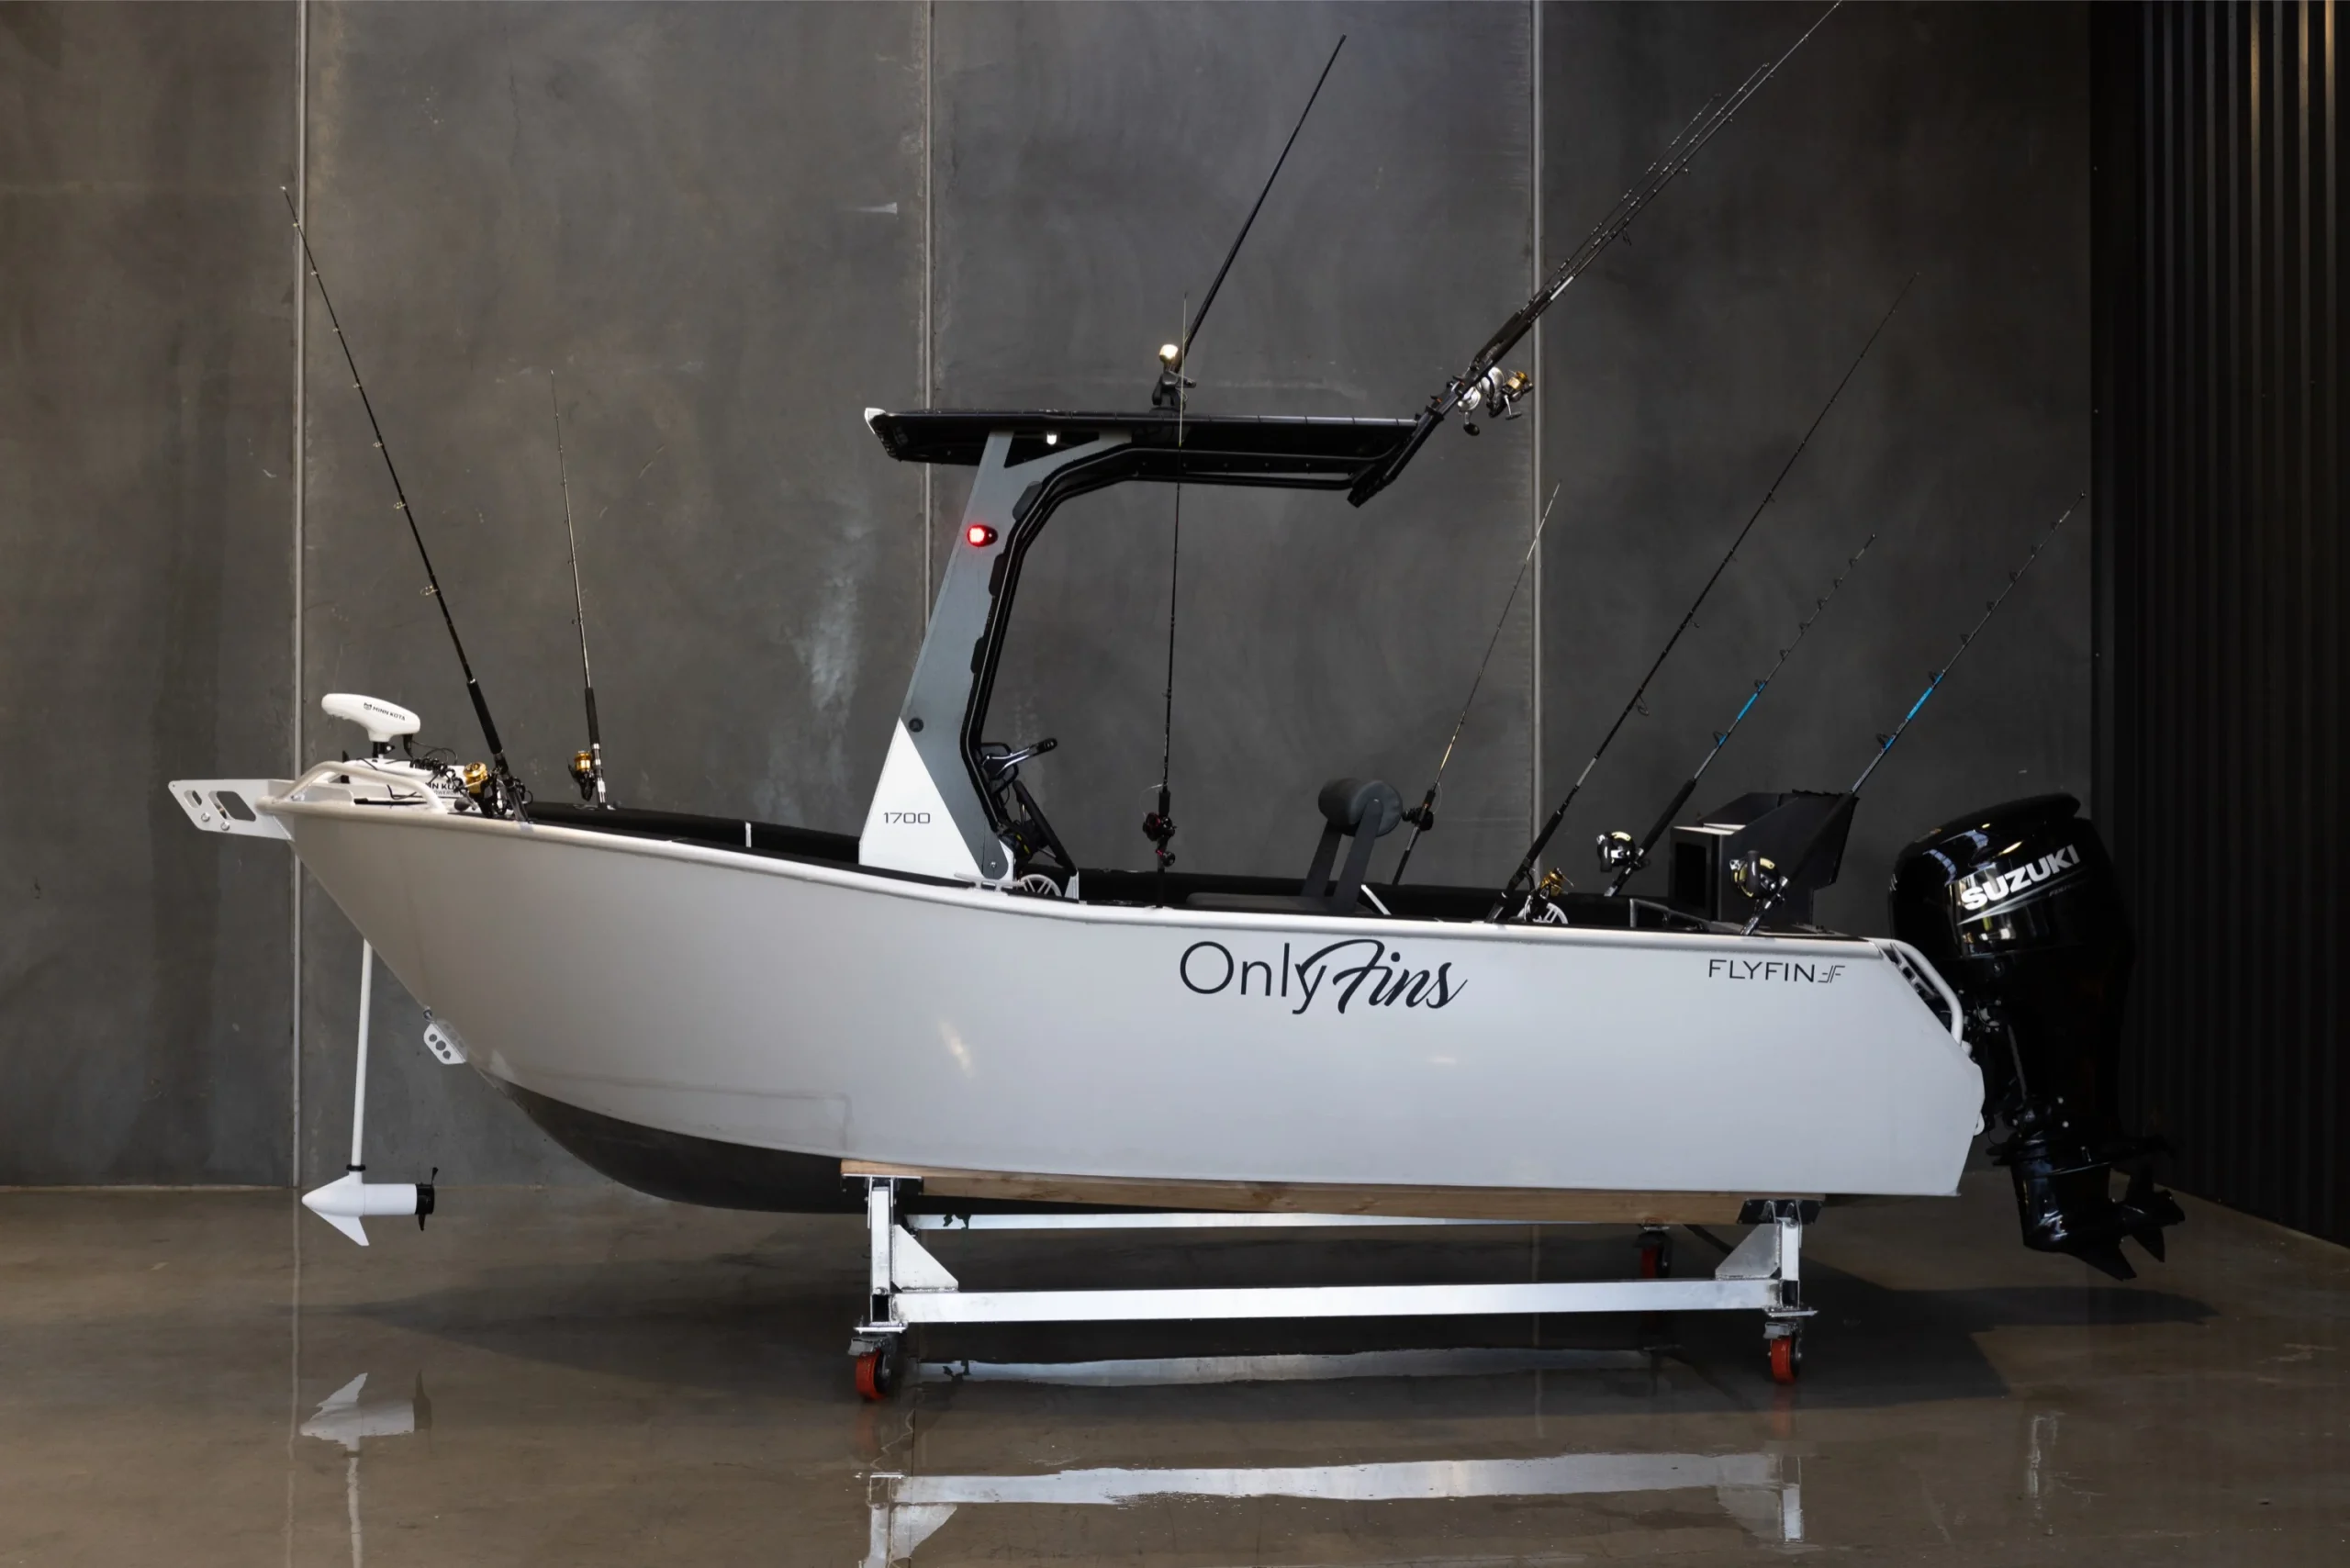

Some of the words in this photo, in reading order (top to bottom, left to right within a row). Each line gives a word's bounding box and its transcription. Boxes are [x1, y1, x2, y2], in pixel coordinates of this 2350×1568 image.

[373, 706, 389, 715] MINN
[389, 711, 406, 721] KOTA
[883, 812, 931, 824] 1700
[1961, 844, 2080, 911] SUZUKI
[1708, 958, 1816, 983] FLYFIN
